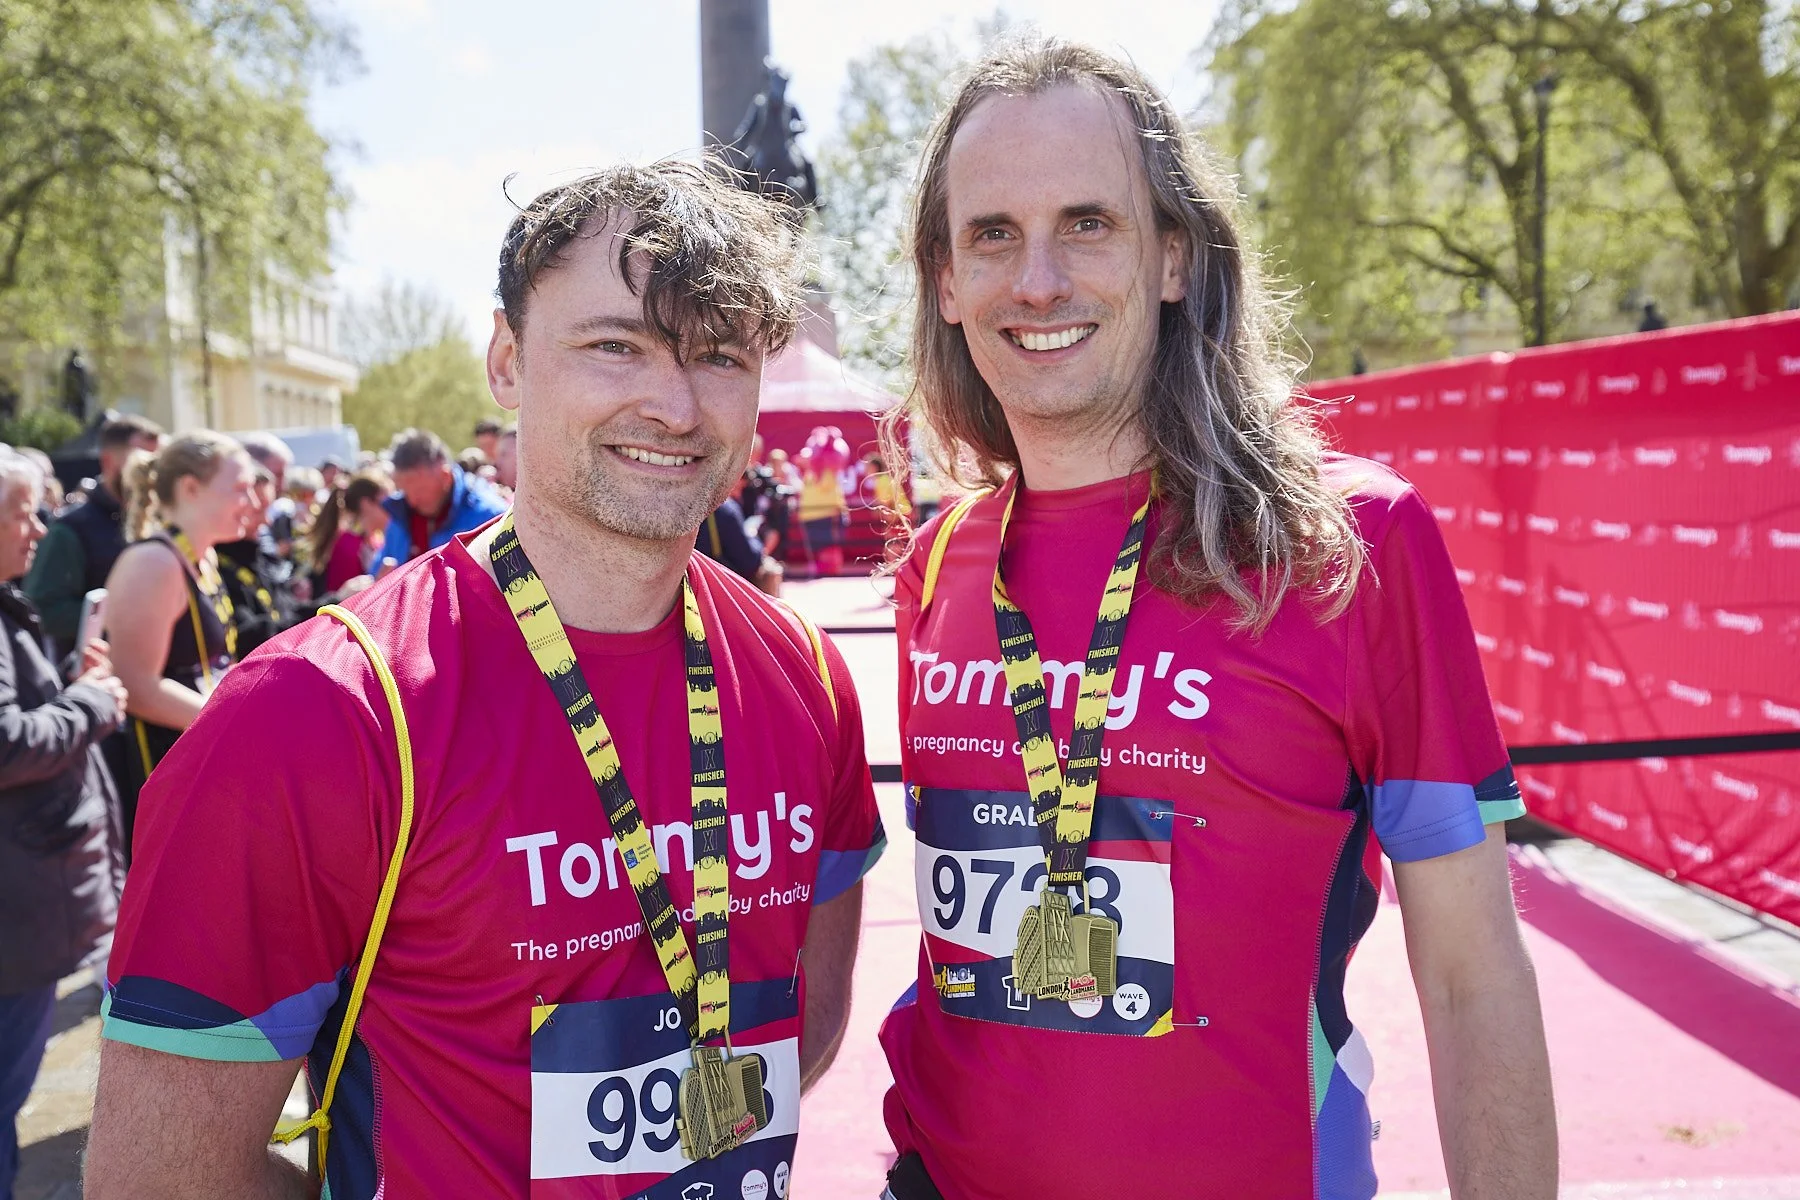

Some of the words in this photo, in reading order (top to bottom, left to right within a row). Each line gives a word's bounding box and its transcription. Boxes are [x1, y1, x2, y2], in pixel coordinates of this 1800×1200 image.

[1001, 632, 1034, 649] FINISHER
[1088, 646, 1120, 660] FINISHER
[688, 665, 713, 676] FINISHER
[566, 692, 594, 717] FINISHER
[1014, 695, 1045, 716] FINISHER
[914, 736, 1005, 758] pregnancy
[1118, 744, 1206, 775] charity
[1067, 757, 1099, 770] FINISHER
[694, 769, 725, 783] FINISHER
[610, 799, 636, 825] FINISHER
[694, 815, 725, 830] FINISHER
[1049, 871, 1082, 882] FINISHER
[511, 939, 558, 961] The
[759, 881, 811, 908] charity
[650, 904, 675, 931] FINISHER
[697, 928, 727, 945] FINISHER
[1038, 983, 1063, 997] LONDON
[1070, 985, 1096, 996] LANDMARKS
[1118, 992, 1144, 1000] WAVE
[1125, 1001, 1138, 1015] 4
